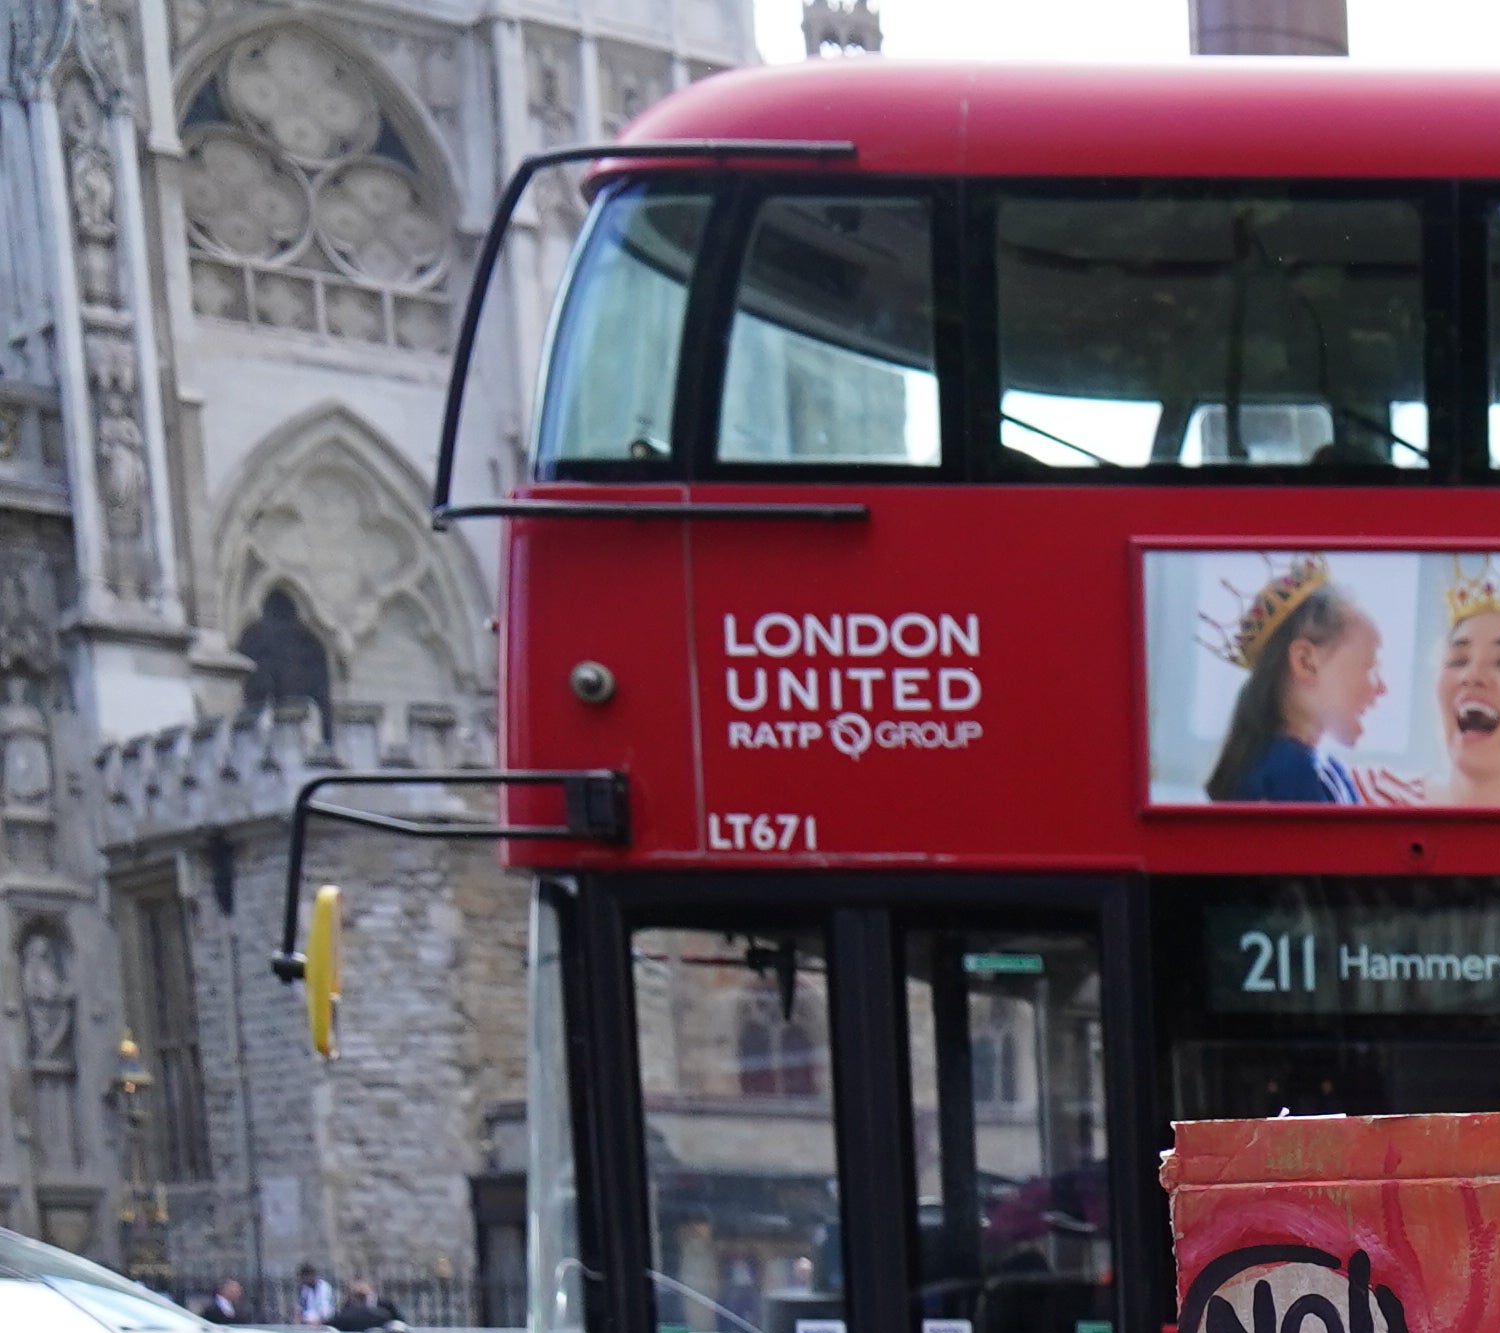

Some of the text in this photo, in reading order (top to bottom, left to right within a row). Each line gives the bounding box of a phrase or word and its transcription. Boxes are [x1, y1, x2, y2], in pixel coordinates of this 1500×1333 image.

[724, 612, 980, 657] LONDON
[726, 667, 982, 712] UNITED
[728, 720, 984, 749] RATP GROUP
[708, 813, 817, 850] LT671
[1240, 931, 1317, 993] 211
